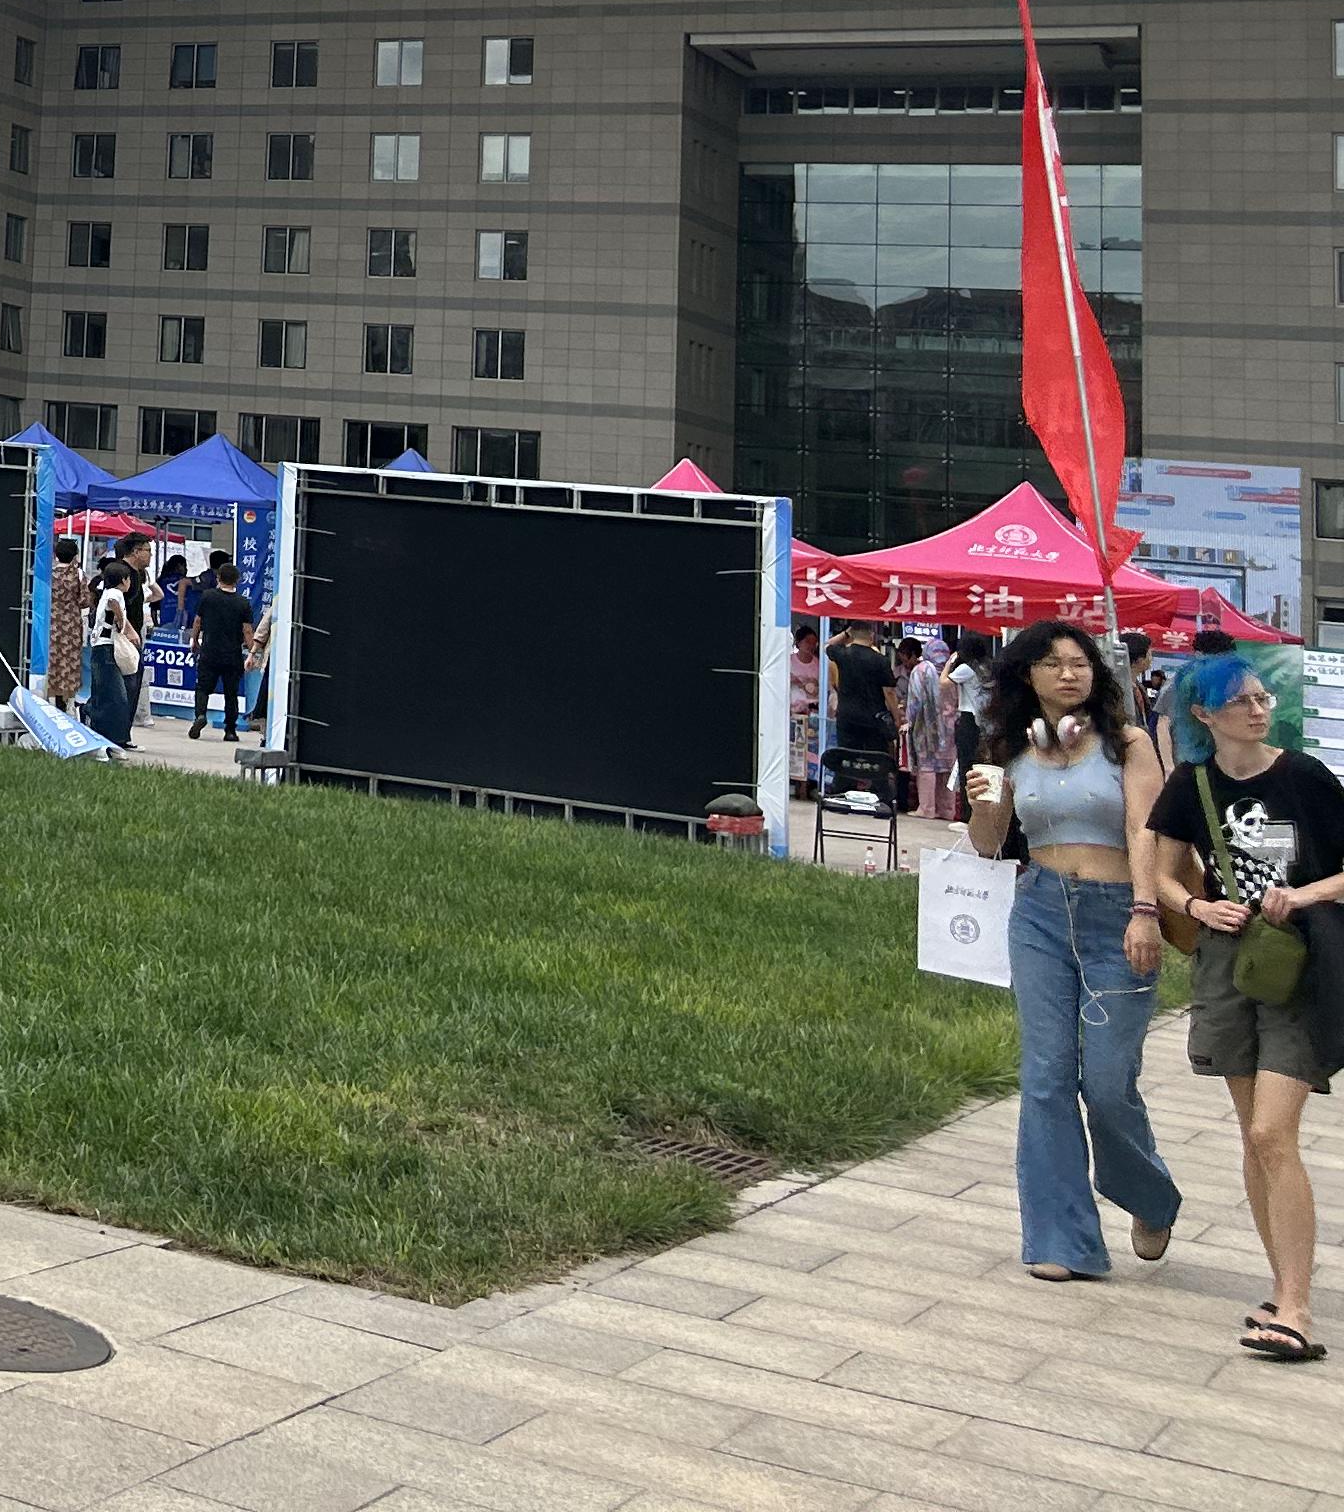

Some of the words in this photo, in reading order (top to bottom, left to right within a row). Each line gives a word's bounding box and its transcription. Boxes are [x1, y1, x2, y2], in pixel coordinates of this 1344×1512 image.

[796, 567, 1114, 628] 长加油站
[155, 648, 195, 667] 2024
